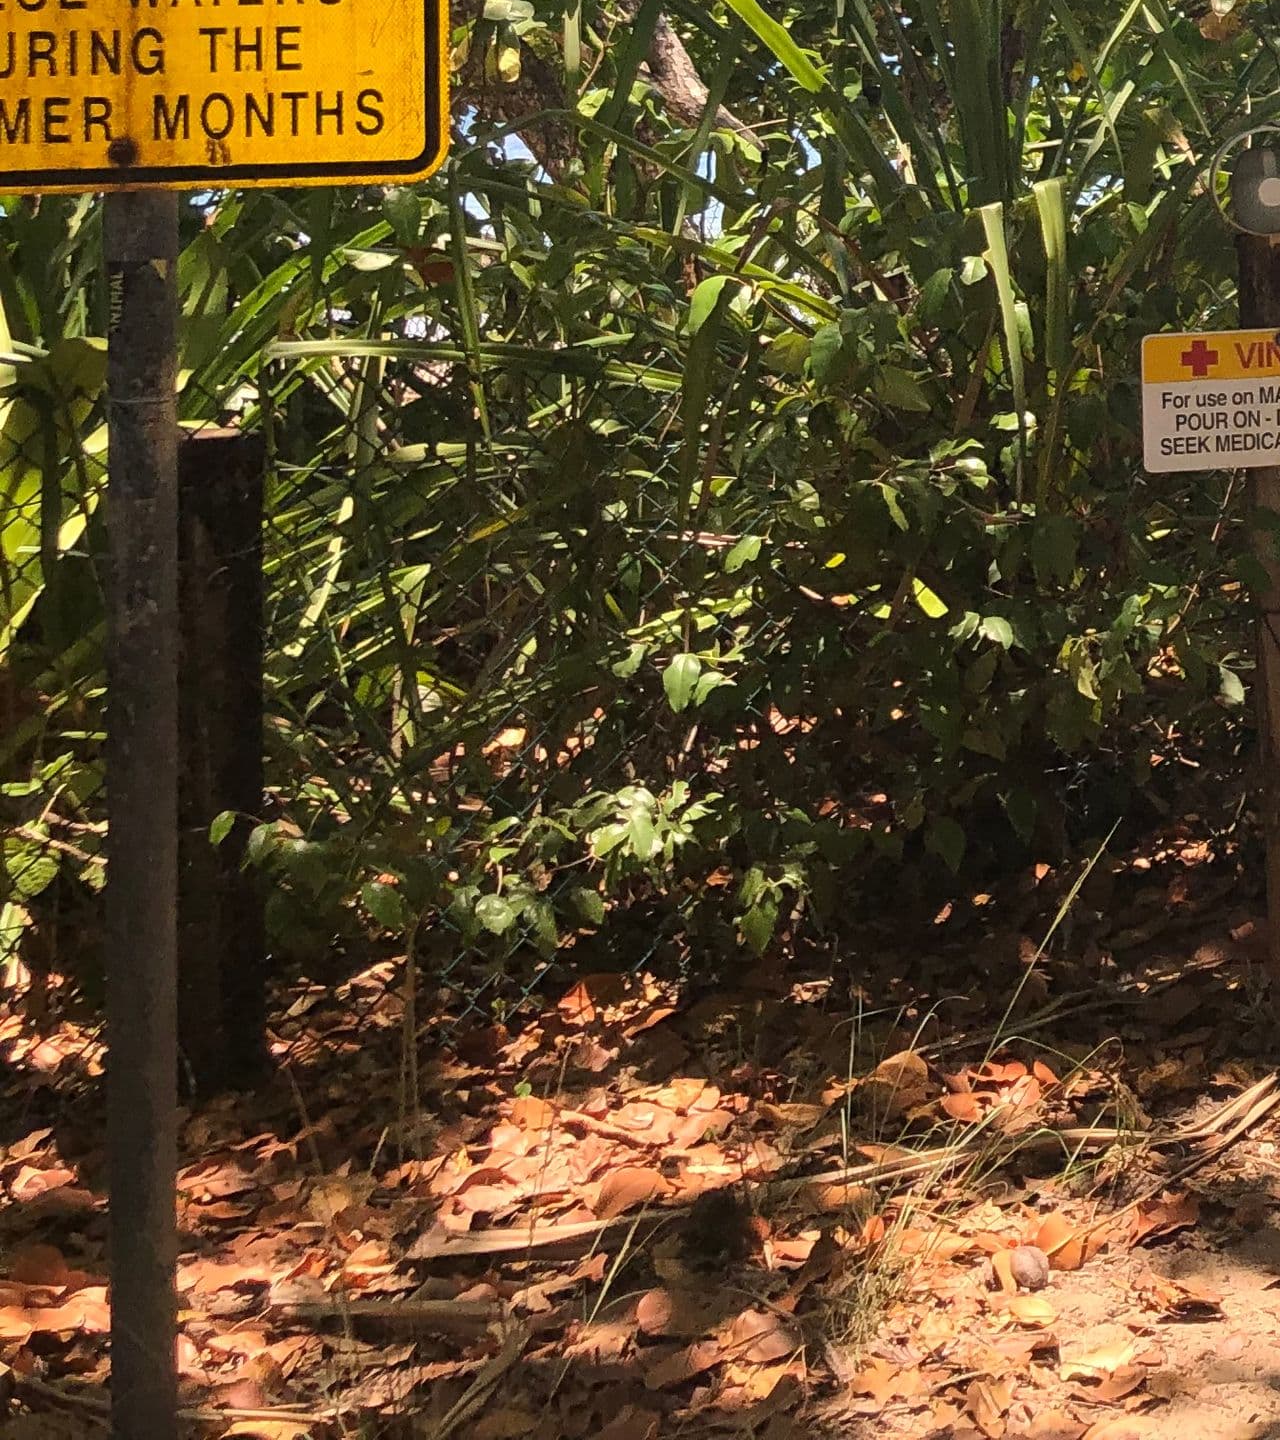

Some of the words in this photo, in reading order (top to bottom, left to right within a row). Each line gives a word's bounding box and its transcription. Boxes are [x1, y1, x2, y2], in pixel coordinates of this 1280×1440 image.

[199, 26, 302, 72] THE
[153, 89, 385, 140] MONTHS
[1162, 392, 1190, 409] For
[1195, 393, 1227, 408] use
[1231, 392, 1254, 405] on
[1175, 411, 1228, 432] POUR
[1233, 410, 1261, 428] ON
[1160, 436, 1211, 456] SEEK
